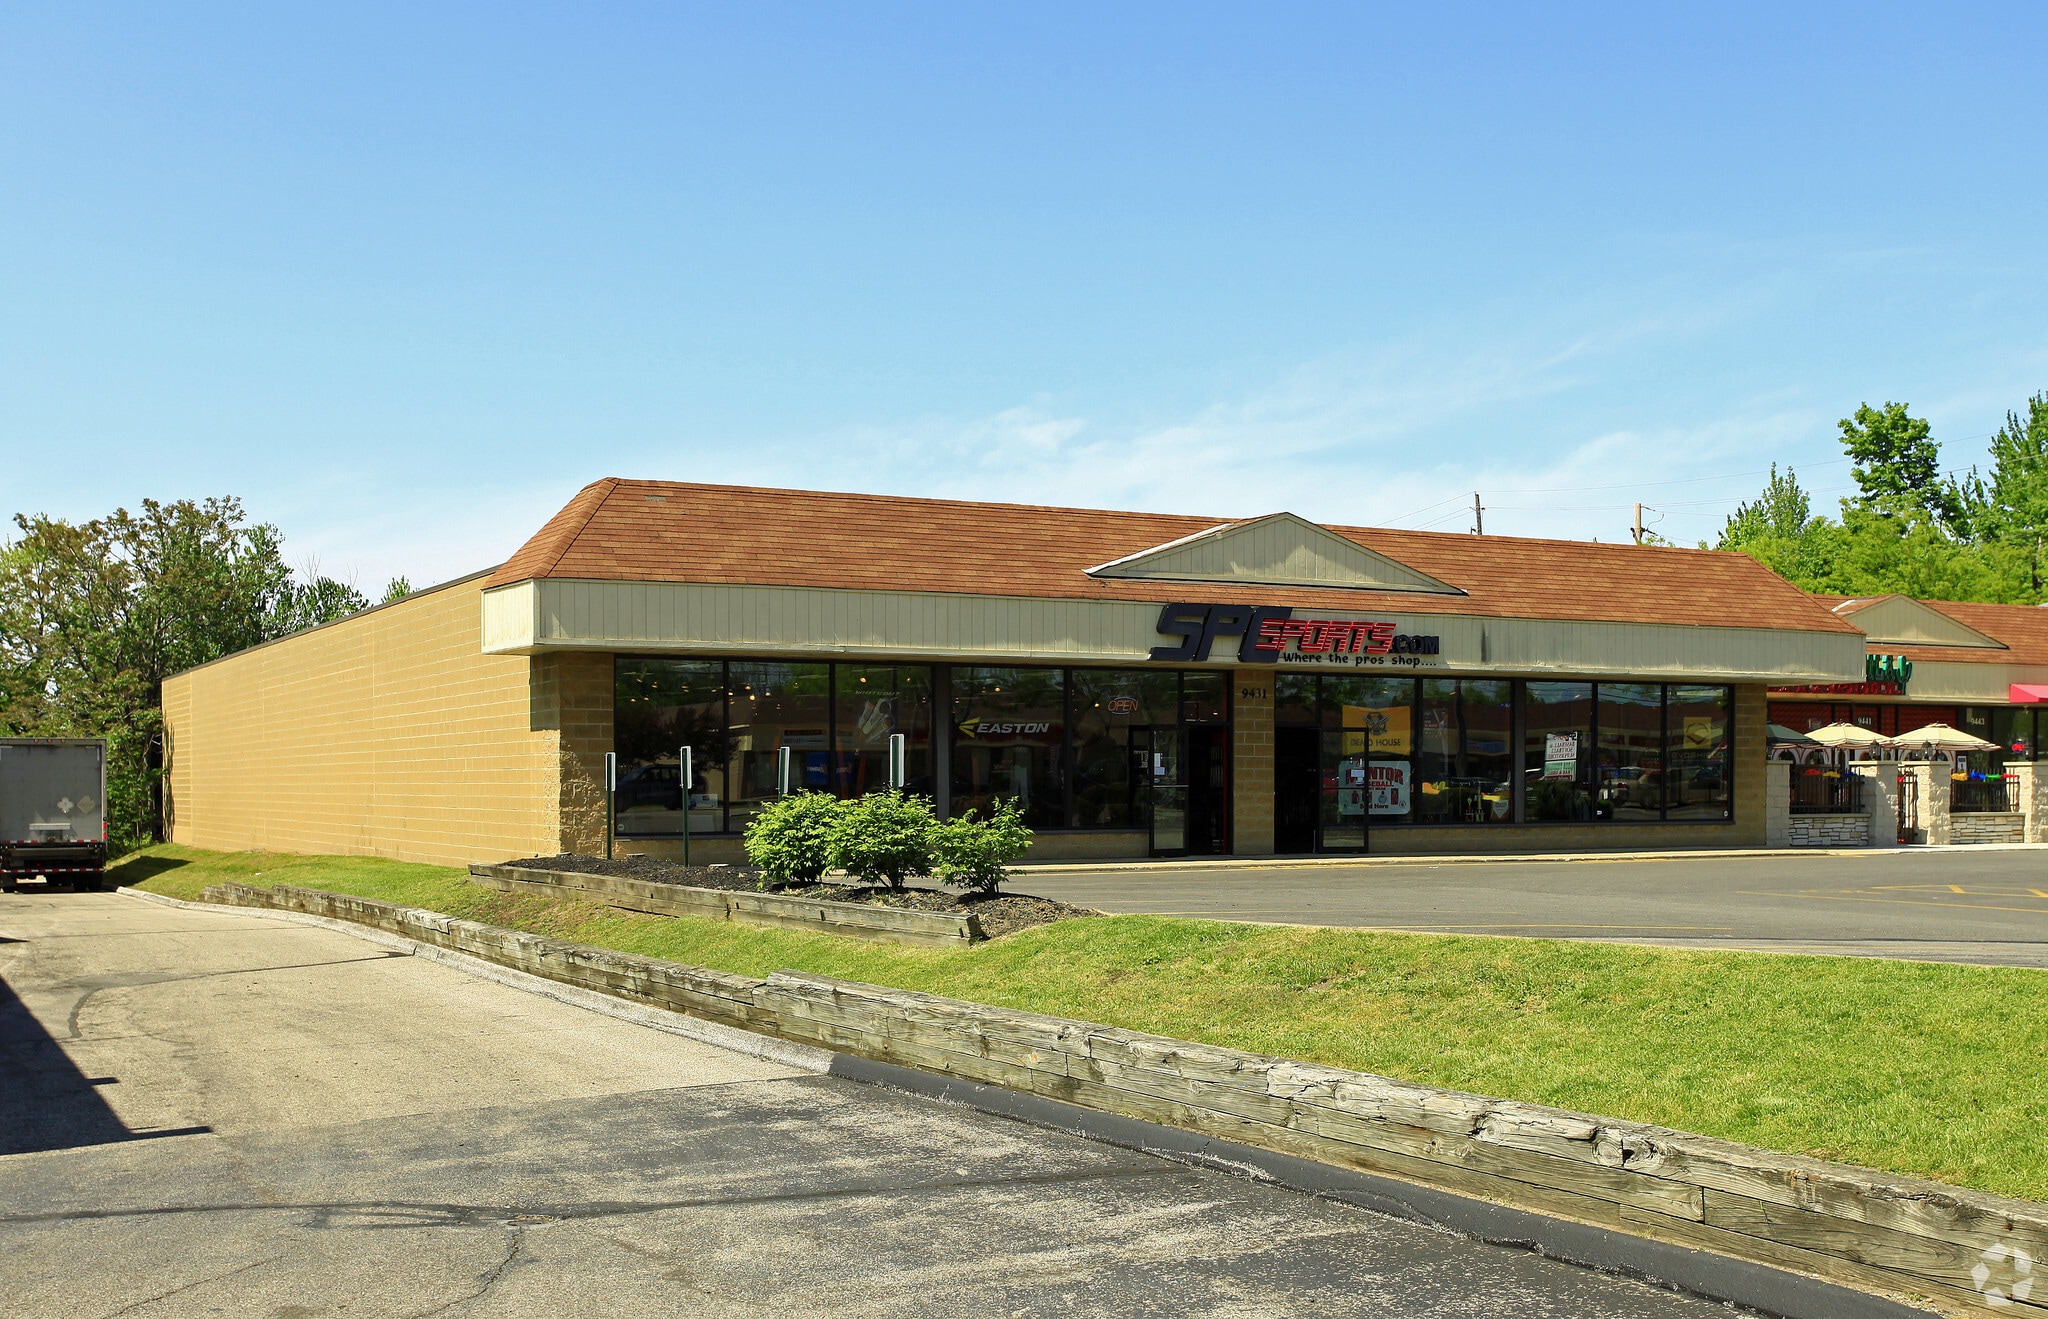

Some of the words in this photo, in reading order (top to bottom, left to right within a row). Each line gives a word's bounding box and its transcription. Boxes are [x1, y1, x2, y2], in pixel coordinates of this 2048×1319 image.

[1283, 652, 1322, 663] Where
[1328, 653, 1349, 664] the
[1355, 655, 1384, 667] pros
[1241, 687, 1267, 699] 9431
[1108, 699, 1139, 712] OPEN
[1857, 717, 1872, 725] 9441
[1970, 717, 1985, 726] 9443
[976, 722, 1050, 734] EASTON
[1375, 738, 1401, 747] HOUSE
[1345, 766, 1404, 786] MNTOR
